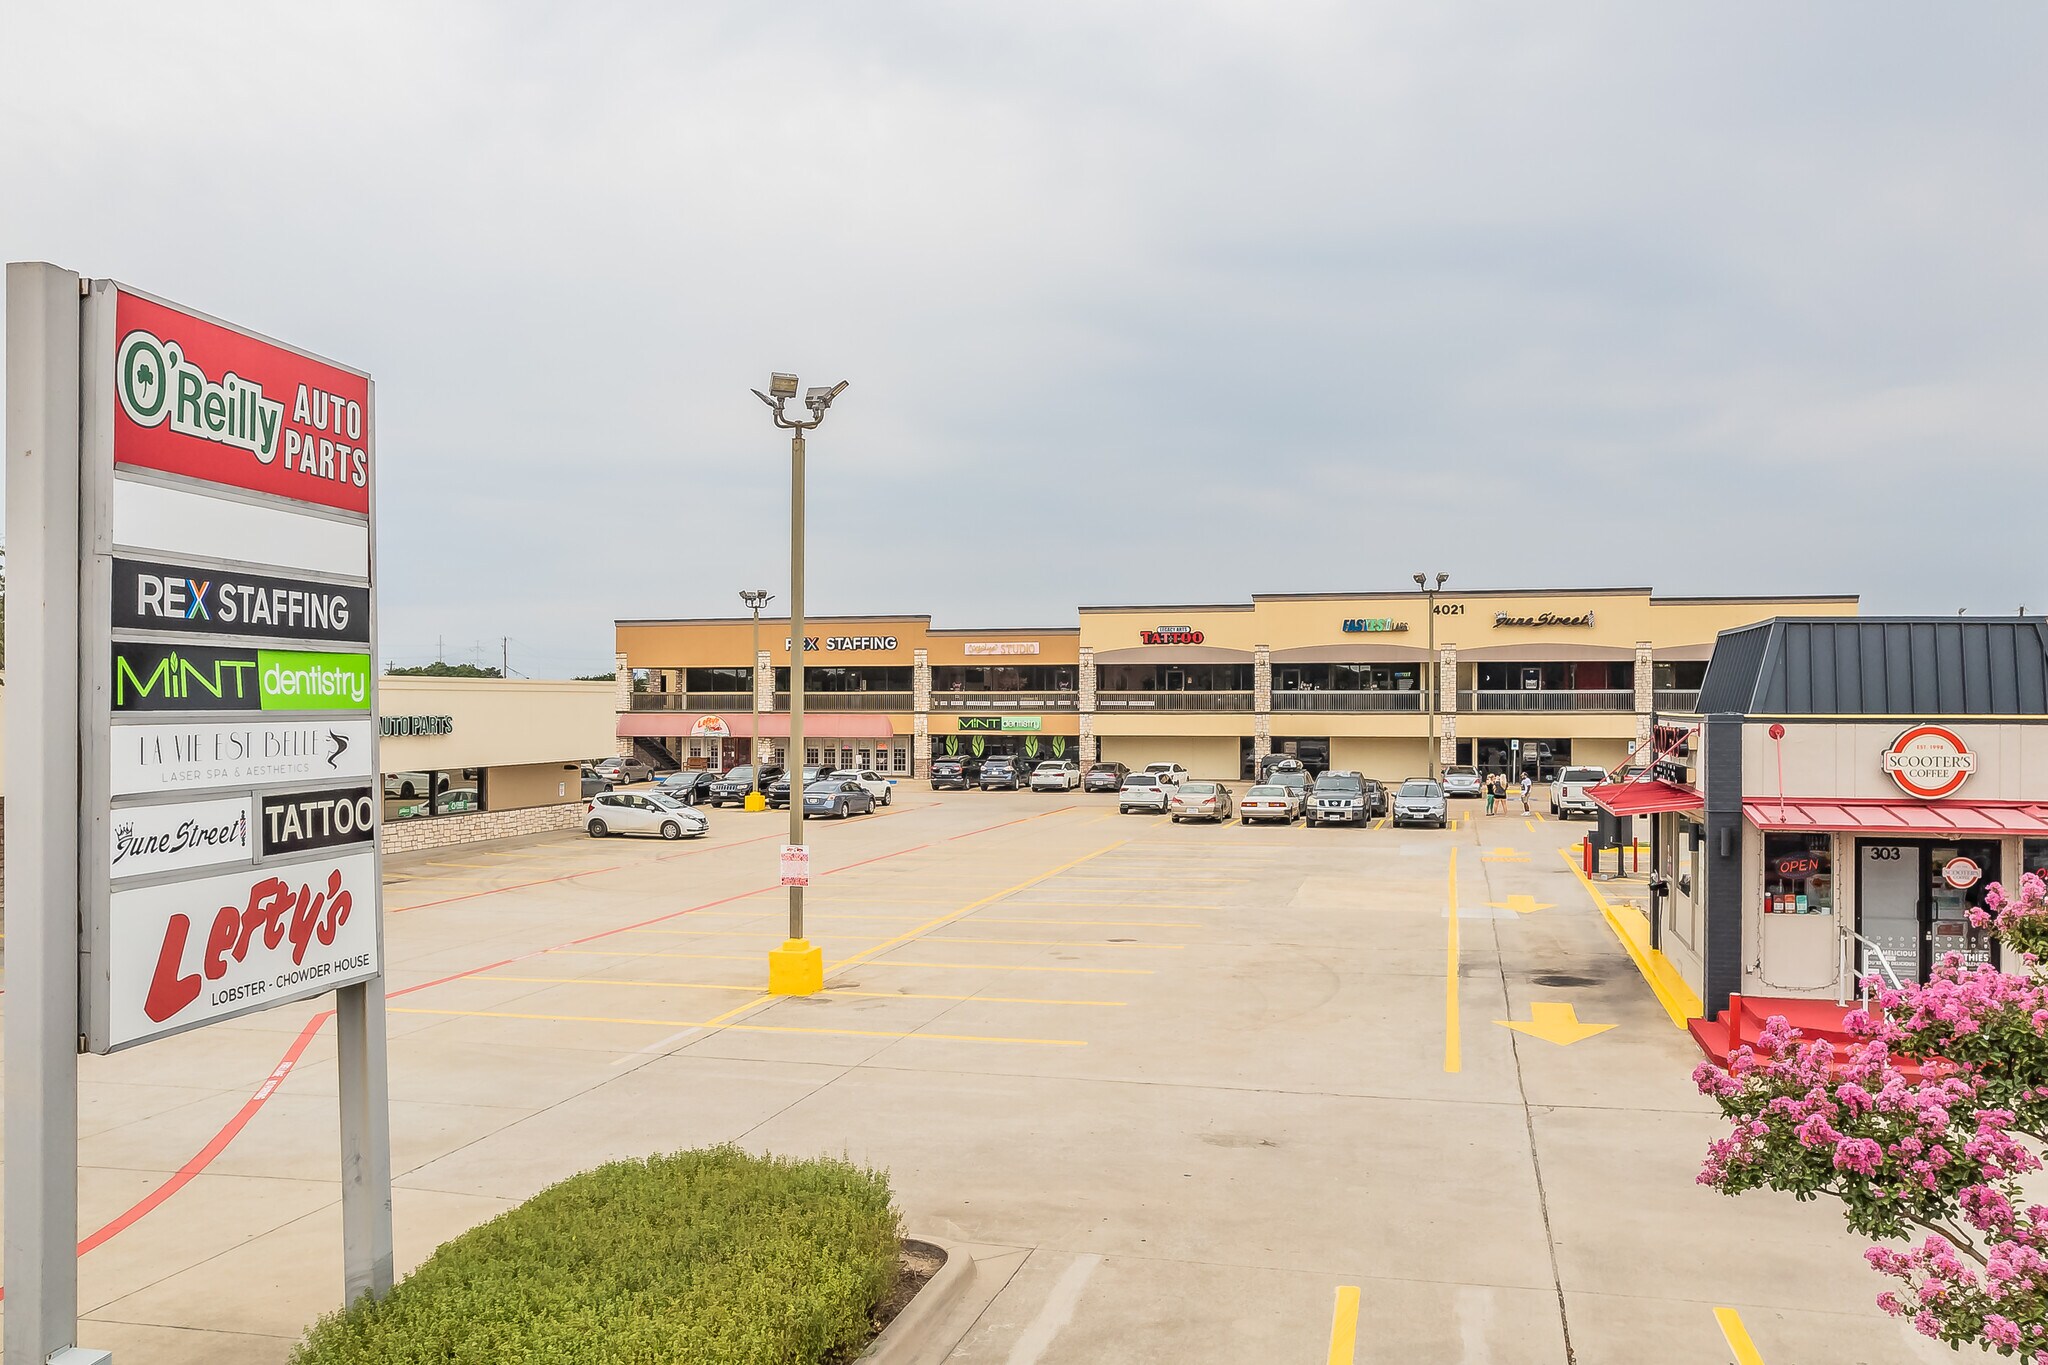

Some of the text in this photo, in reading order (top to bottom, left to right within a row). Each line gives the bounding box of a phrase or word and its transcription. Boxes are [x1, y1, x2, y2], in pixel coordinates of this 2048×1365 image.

[123, 338, 279, 456] O'Reilly
[293, 384, 361, 440] AUTO
[284, 430, 367, 488] PARTS
[137, 574, 349, 631] REX STAFFING
[1432, 604, 1465, 615] 4021
[1532, 612, 1589, 627] Street
[826, 636, 898, 651] STAFFING
[1140, 631, 1204, 644] TATTOO
[264, 663, 366, 703] dentistry
[412, 715, 453, 736] PARTS
[140, 729, 320, 766] LA VIE EST BELLE
[1889, 755, 1971, 768] SCOOTER'S
[161, 763, 310, 783] LASER SPA & AESTHETICS
[1909, 769, 1949, 778] COFFEE
[266, 796, 373, 844] TATTOO
[112, 818, 240, 866] June Street
[1871, 847, 1900, 860] 303
[1780, 858, 1819, 873] OPEN
[144, 869, 352, 1023] Lefty's
[211, 981, 266, 1007] LOBSTER
[276, 964, 331, 990] CHOWDER
[334, 953, 371, 979] HOUSE
